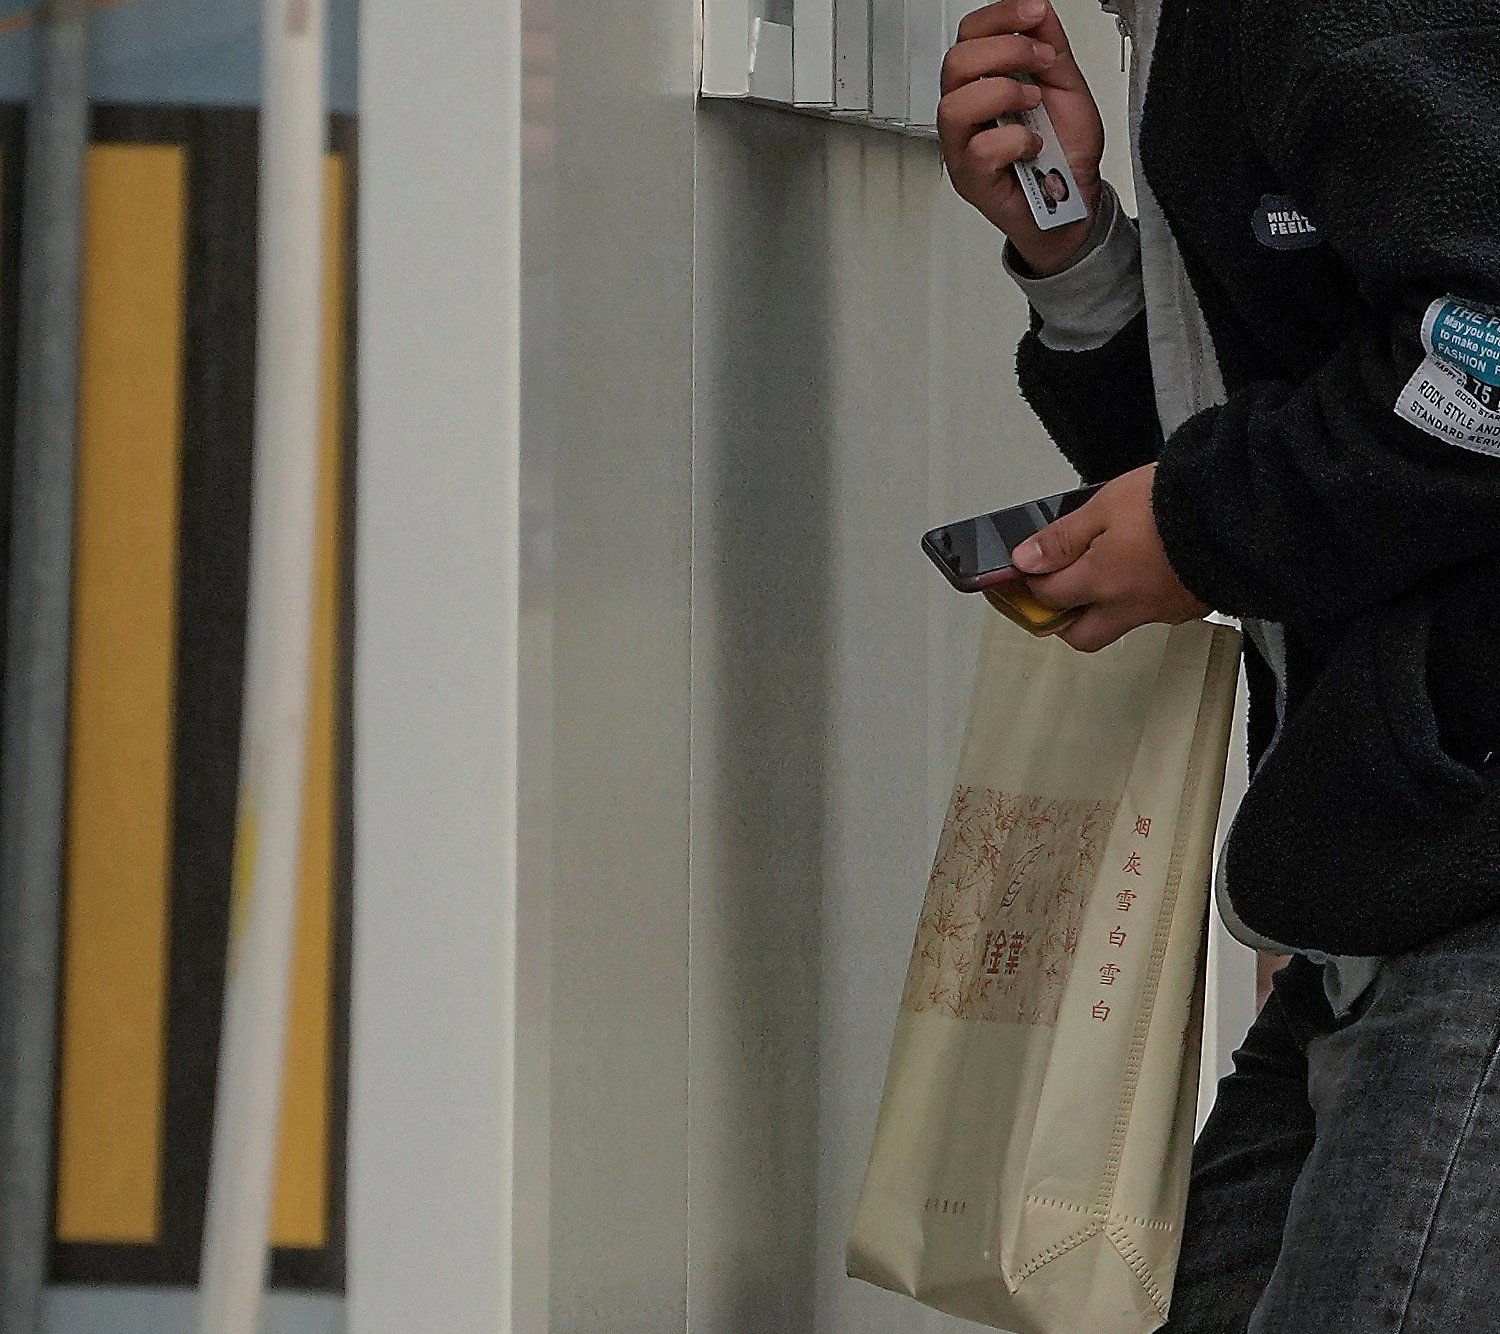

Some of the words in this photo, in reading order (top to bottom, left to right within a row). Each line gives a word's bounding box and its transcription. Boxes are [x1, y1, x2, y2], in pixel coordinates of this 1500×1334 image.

[1443, 314, 1465, 333] May
[1463, 321, 1484, 339] you
[1451, 305, 1487, 325] THE
[1437, 342, 1487, 373] FASHION
[1439, 329, 1450, 340] to
[1451, 334, 1479, 352] make
[1479, 345, 1500, 361] you
[1434, 360, 1456, 380] HAPPY
[1472, 378, 1493, 404] 75
[1410, 400, 1465, 440] STANDARD
[1417, 379, 1446, 410] ROCK
[1443, 402, 1476, 431] STYLE
[1476, 423, 1500, 437] AND
[1091, 814, 1152, 1022] 烟灰雪白雪白
